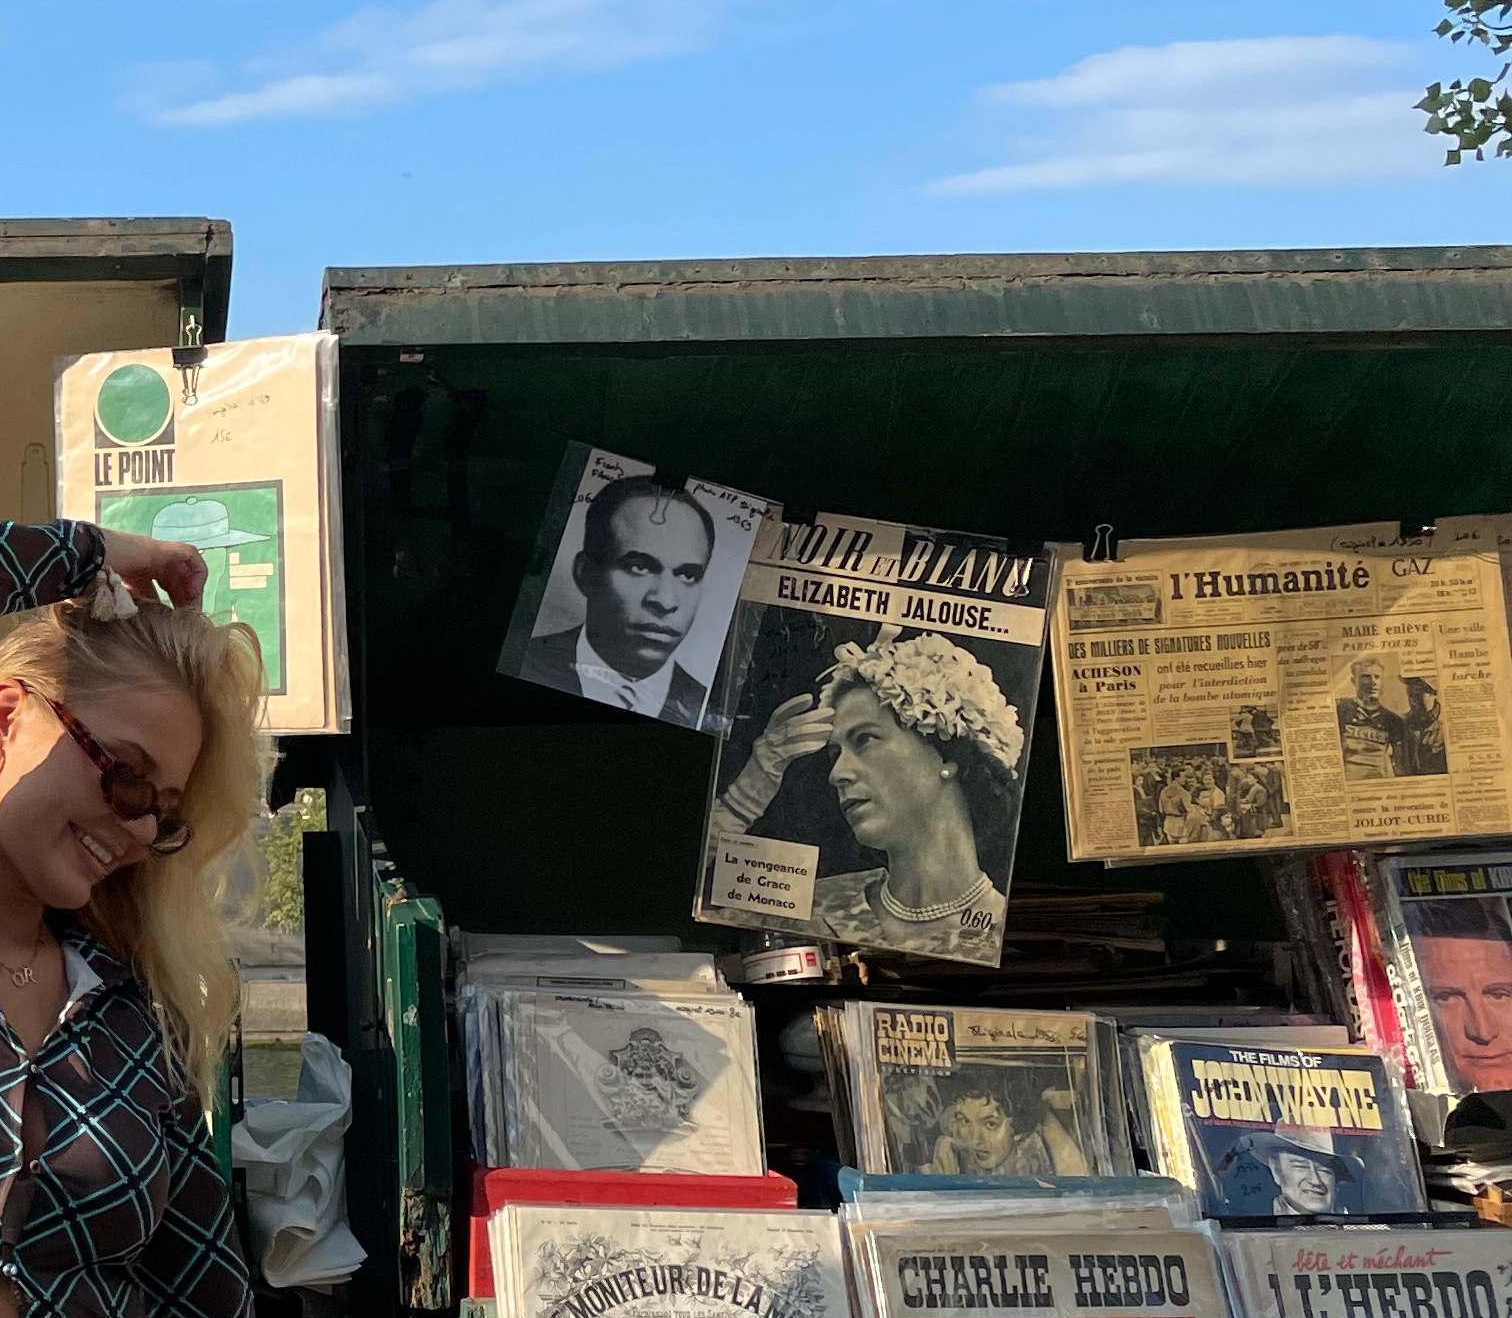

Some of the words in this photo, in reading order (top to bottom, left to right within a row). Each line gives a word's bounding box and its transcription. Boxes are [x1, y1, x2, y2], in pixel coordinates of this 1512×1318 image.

[94, 452, 112, 486] LE
[118, 449, 176, 486] POINT
[767, 523, 874, 572] NOIR
[870, 557, 900, 578] ET
[1391, 557, 1436, 578] GAZ
[1170, 560, 1370, 600] l'Humanité
[778, 576, 890, 615] ELIZABETH
[901, 596, 1009, 634] JALOUSE...
[1068, 642, 1086, 659] DES
[1091, 639, 1134, 658] MILLIERS
[1138, 638, 1151, 655] DE
[1154, 635, 1212, 654] SIGNATURES
[1217, 632, 1271, 651] NOUVELLES
[1342, 638, 1419, 652] PARIS-TOURS
[1449, 648, 1489, 659] flambe
[1071, 665, 1142, 680] ACHESON
[1157, 662, 1173, 675] ont
[1176, 660, 1191, 673] été
[1193, 657, 1245, 673] recueillies
[1247, 654, 1268, 670] hier
[1079, 681, 1088, 693] à
[1095, 680, 1137, 693] Paris
[1158, 680, 1185, 692] pour
[1192, 674, 1267, 689] l'interdiction
[1152, 694, 1167, 704] de
[1168, 693, 1180, 703] la
[1183, 691, 1220, 703] bombe
[1222, 688, 1277, 703] atomique
[1354, 813, 1451, 828] JOLIOT-CURIE
[725, 852, 738, 864] La
[745, 859, 808, 876] vengeance
[736, 872, 751, 885] de
[757, 876, 791, 891] Grace
[727, 889, 742, 901] de
[748, 892, 796, 910] Monaco
[876, 1012, 949, 1042] RADIO
[878, 1038, 952, 1068] CINEMA
[1228, 1049, 1258, 1065] THE
[1259, 1051, 1299, 1068] FILMS
[1301, 1055, 1323, 1069] OF
[1191, 1059, 1273, 1123] JOHN
[1265, 1065, 1383, 1130] WAYNE
[1292, 1248, 1332, 1273] bête
[1336, 1249, 1360, 1270] et
[1362, 1245, 1454, 1270] méchant
[697, 1265, 729, 1298] DE
[732, 1276, 764, 1315] LA
[898, 1254, 1055, 1309] CHARLIE
[1069, 1254, 1191, 1307] HEBDO
